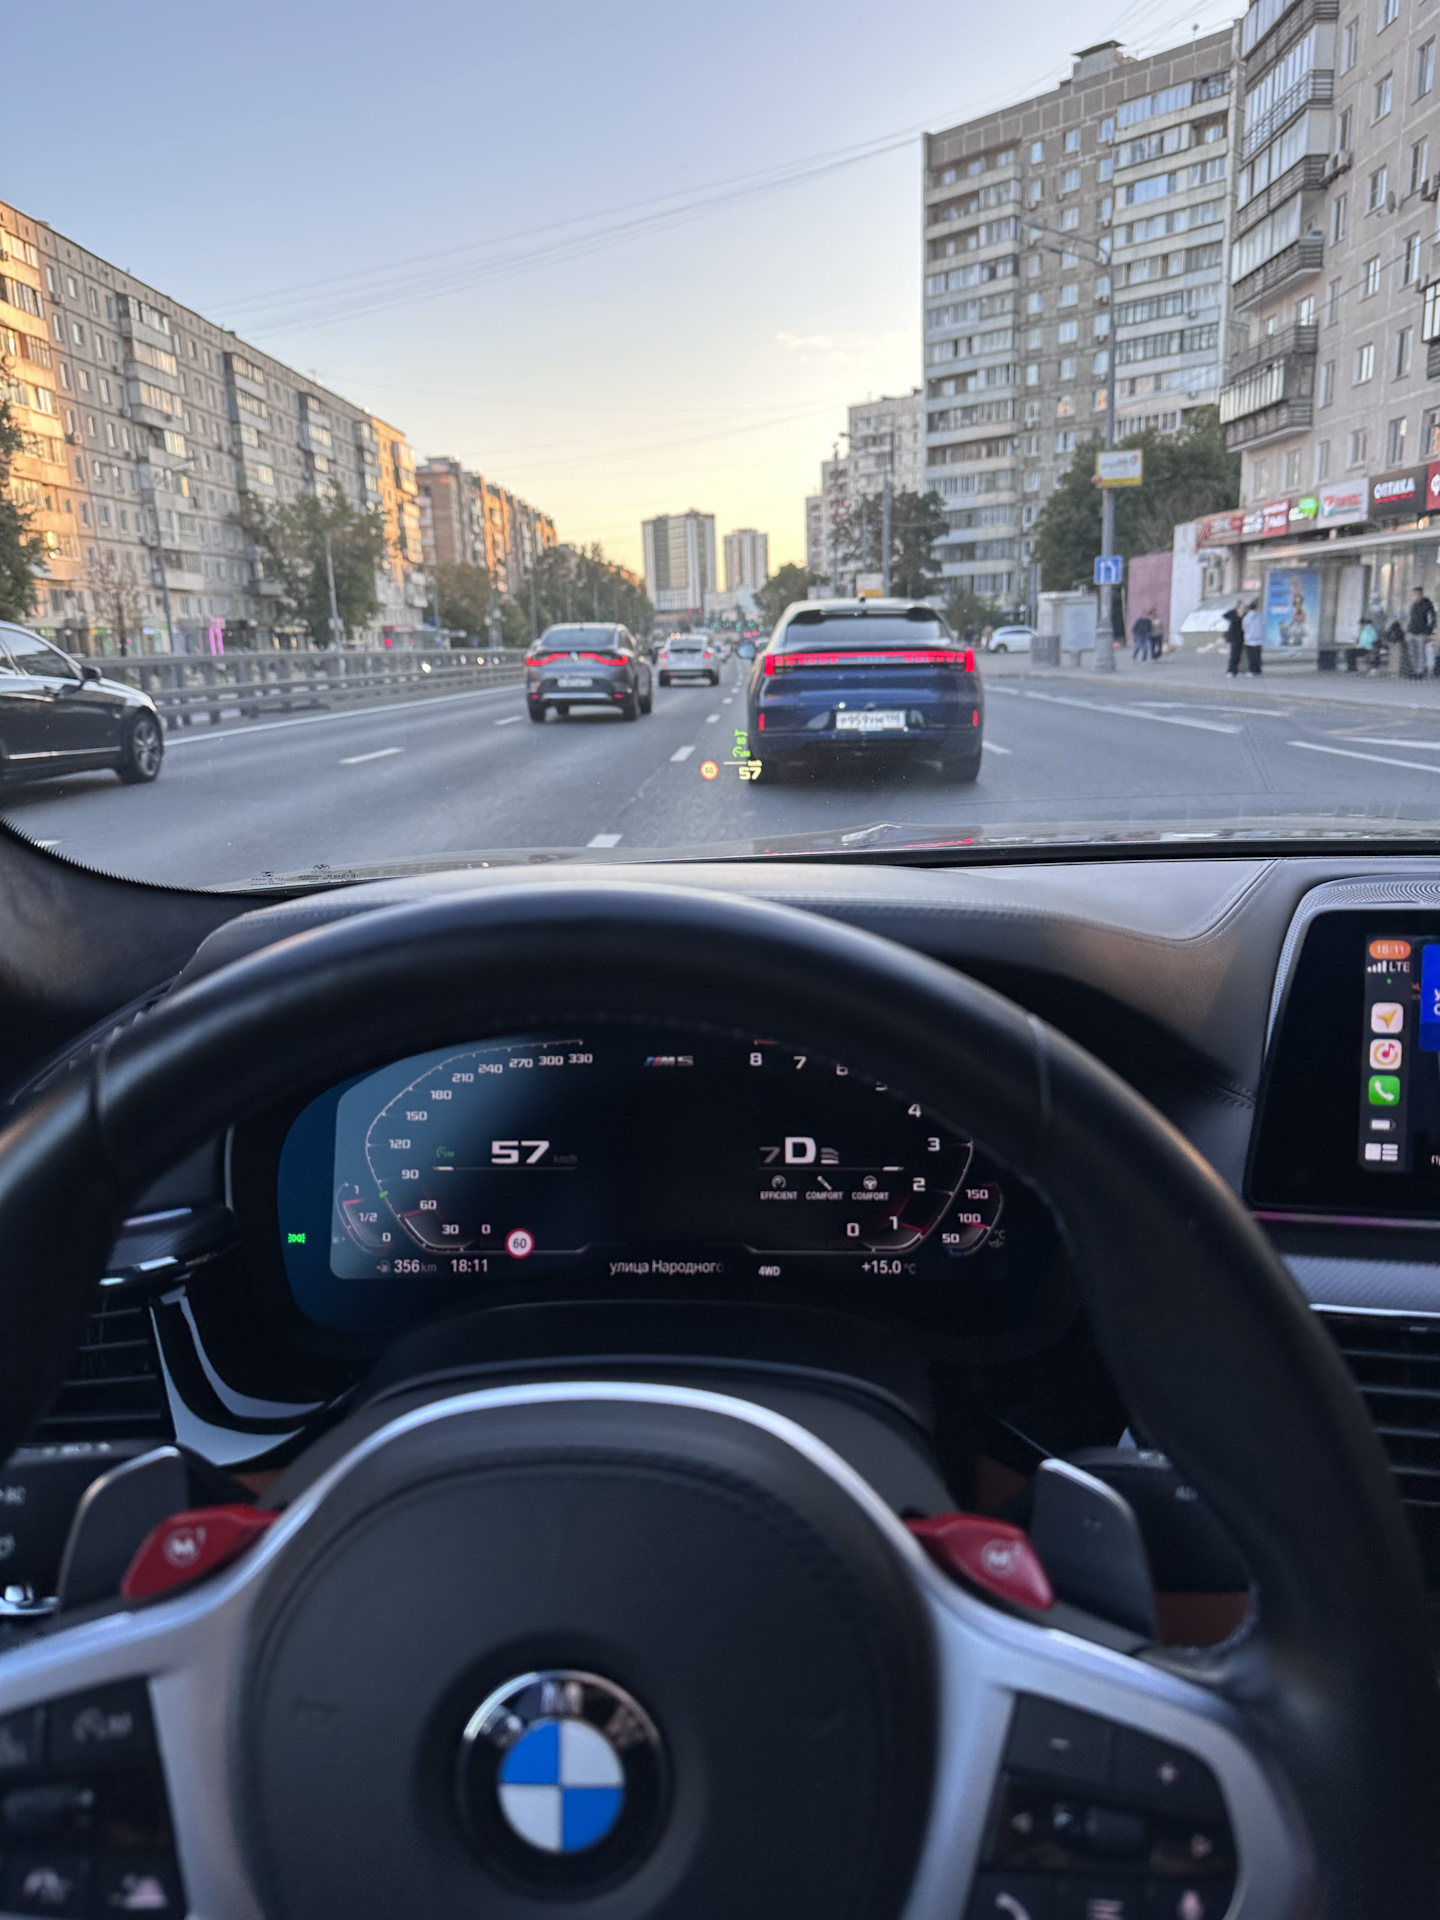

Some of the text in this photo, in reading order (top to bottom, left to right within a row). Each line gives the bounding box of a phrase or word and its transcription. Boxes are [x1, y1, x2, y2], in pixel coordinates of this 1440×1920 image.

[1374, 477, 1416, 500] ОПТИКА
[738, 766, 762, 780] 57
[1377, 944, 1404, 955] 18:11
[1389, 961, 1410, 973] LTE
[508, 1057, 534, 1068] 270
[538, 1055, 564, 1066] 300
[568, 1053, 593, 1064] 330
[749, 1052, 763, 1066] 8
[793, 1055, 807, 1069] 7
[477, 1063, 503, 1074] 240
[451, 1072, 474, 1083] 210
[430, 1089, 453, 1100] 180
[405, 1110, 428, 1121] 150
[907, 1103, 922, 1118] 4
[388, 1138, 411, 1149] 120
[927, 1137, 941, 1152] 3
[491, 1140, 550, 1164] 57
[401, 1169, 420, 1180] 90
[912, 1177, 926, 1192] 2
[760, 1190, 798, 1201] EFFICIENT
[805, 1190, 844, 1201] COMFORT
[851, 1190, 889, 1201] COMFORT
[965, 1188, 989, 1200] 150
[419, 1199, 438, 1210] 60
[358, 1212, 378, 1223] 1/2
[888, 1215, 899, 1230] 1
[957, 1212, 982, 1224] 100
[441, 1224, 460, 1235] 30
[481, 1223, 491, 1235] 0
[846, 1222, 860, 1237] 0
[382, 1231, 391, 1242] 0
[941, 1233, 960, 1244] 50
[512, 1238, 527, 1249] 60
[394, 1259, 438, 1273] 356 km
[450, 1258, 489, 1273] 18:11
[609, 1261, 650, 1276] улица
[758, 1265, 781, 1277] 4WD
[861, 1259, 901, 1274] +15.0
